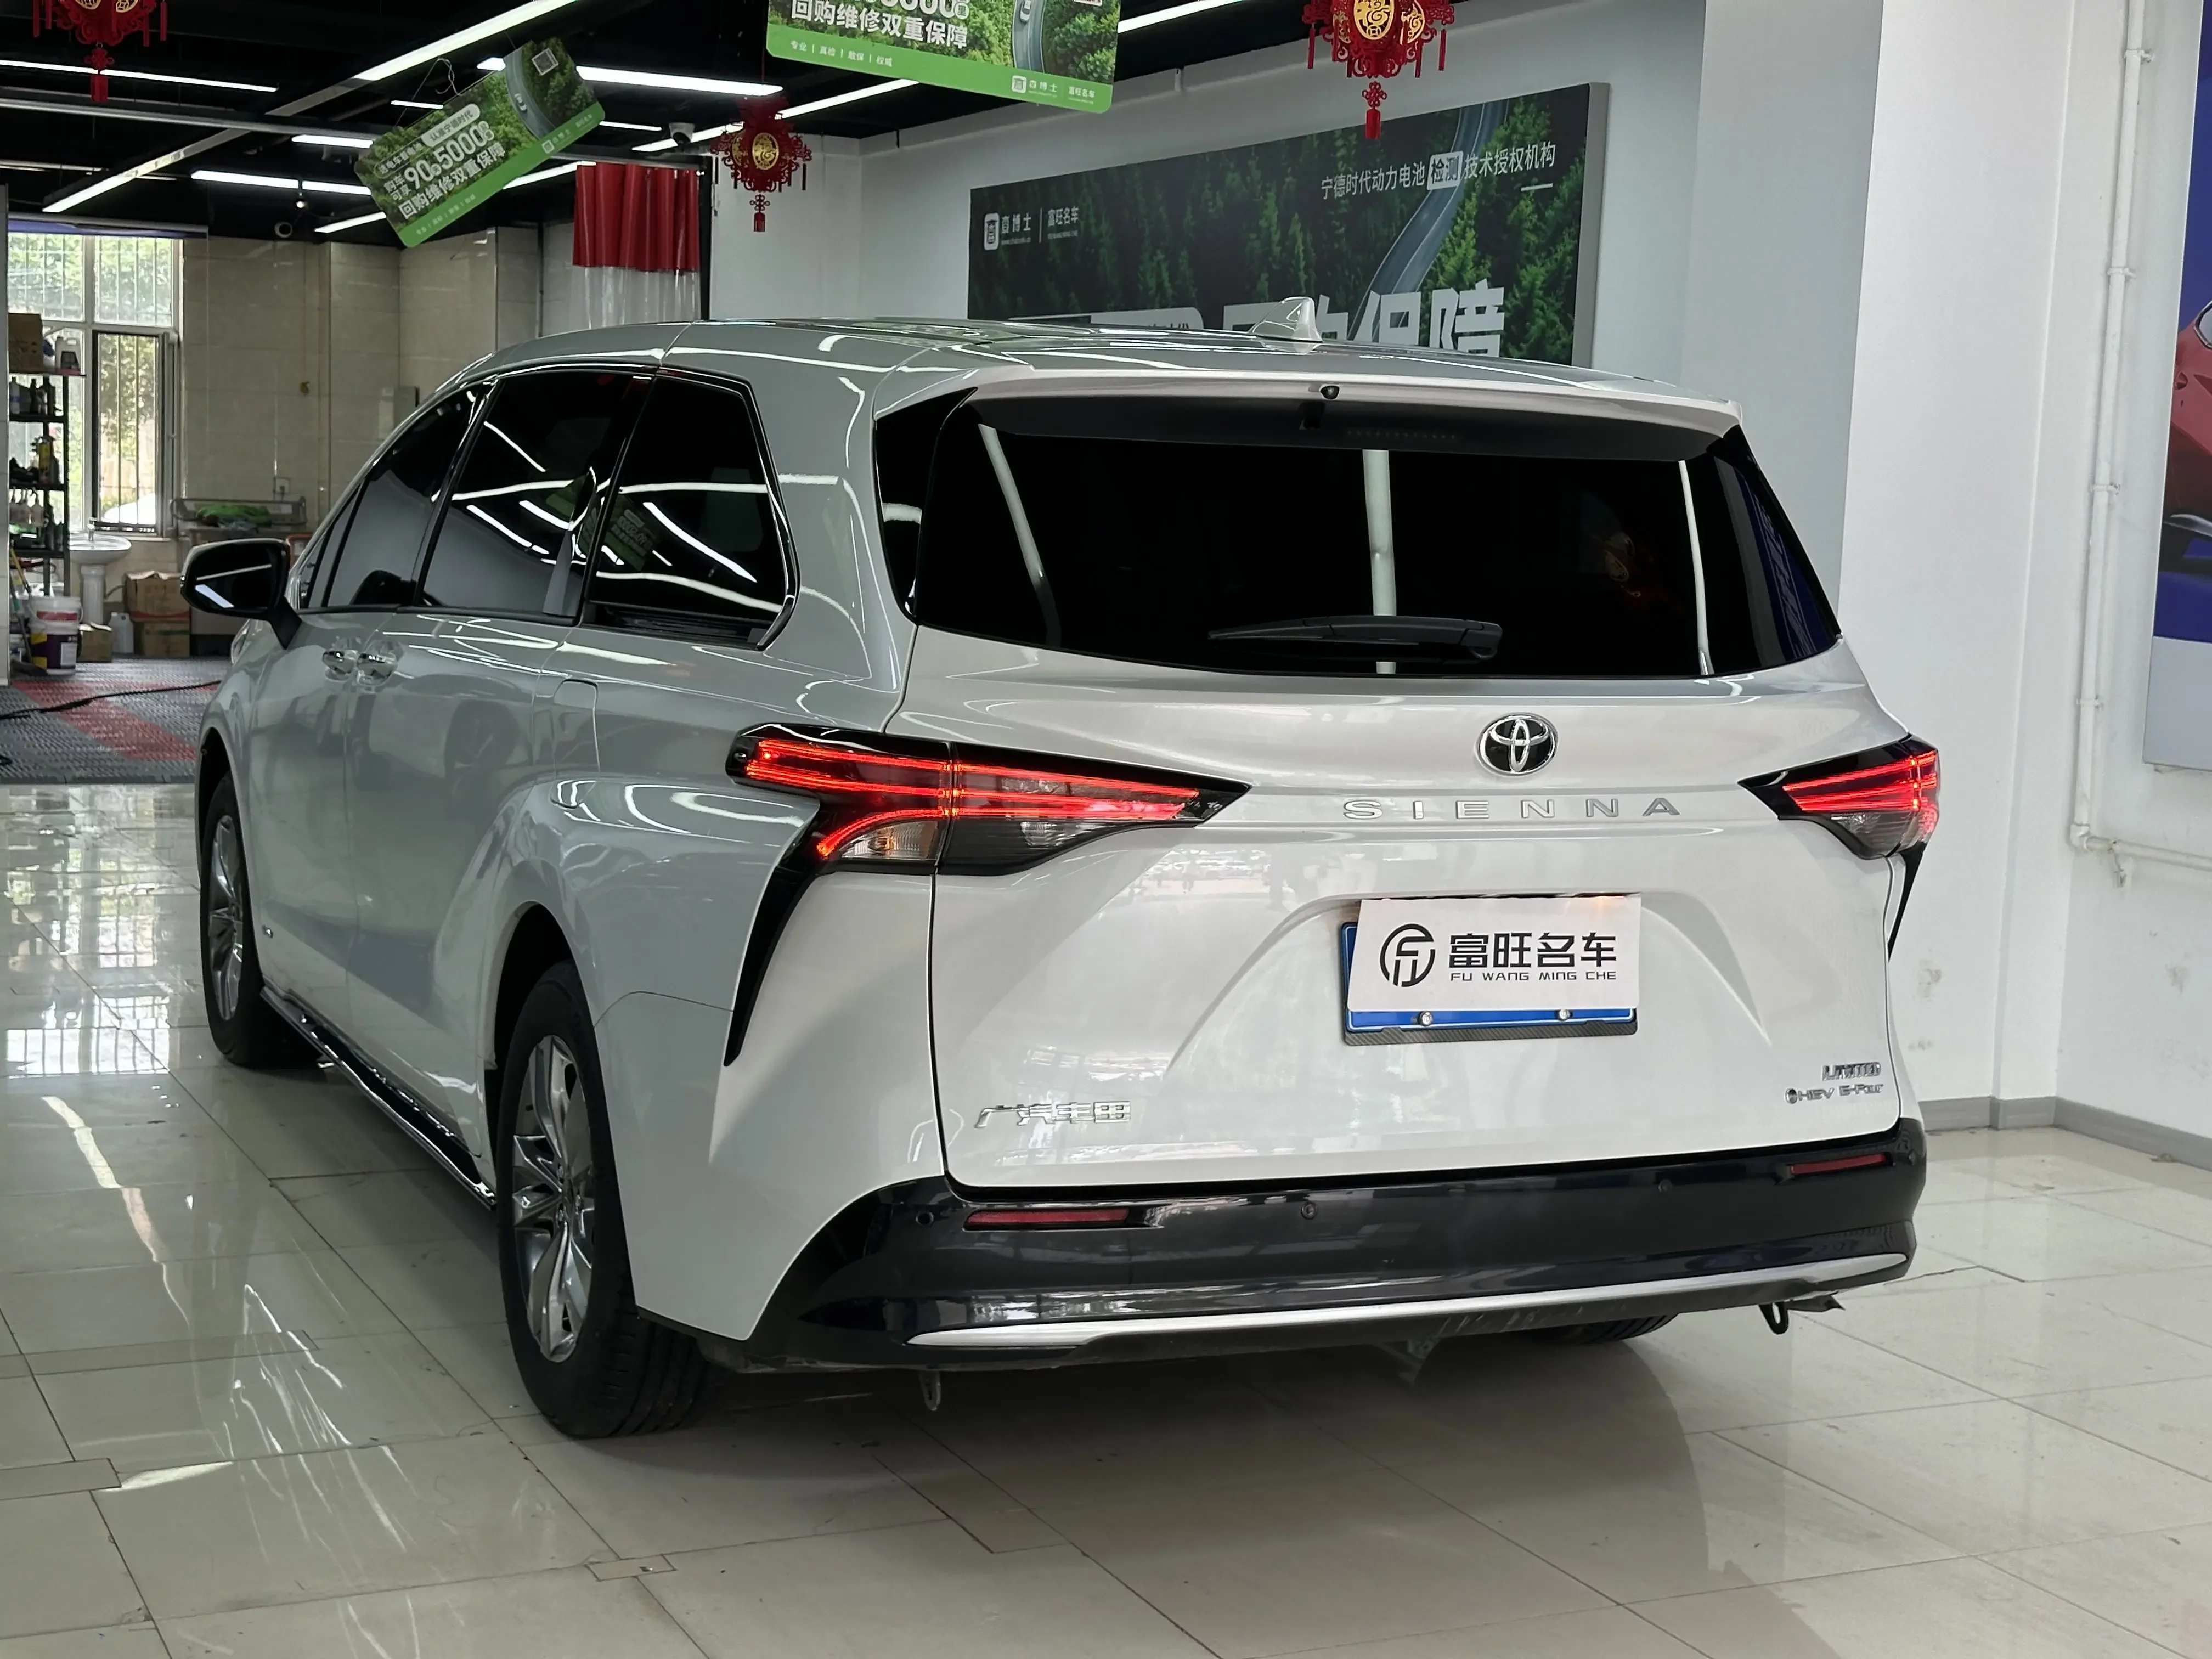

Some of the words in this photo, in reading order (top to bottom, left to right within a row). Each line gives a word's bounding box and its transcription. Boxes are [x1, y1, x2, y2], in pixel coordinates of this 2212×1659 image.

[791, 0, 968, 49] 回购维修双重保障
[398, 141, 506, 219] 回购维修双重保障
[1321, 140, 1556, 200] 宁德时代动力电池检测技术授权机构
[1342, 797, 1680, 820] SIENNA
[1448, 932, 1617, 968] 富旺名车
[1451, 973, 1472, 981] FU
[1482, 972, 1529, 981] WANG
[1538, 972, 1577, 981] MING
[1585, 971, 1616, 980] CHE
[1798, 1087, 1835, 1101] HEV
